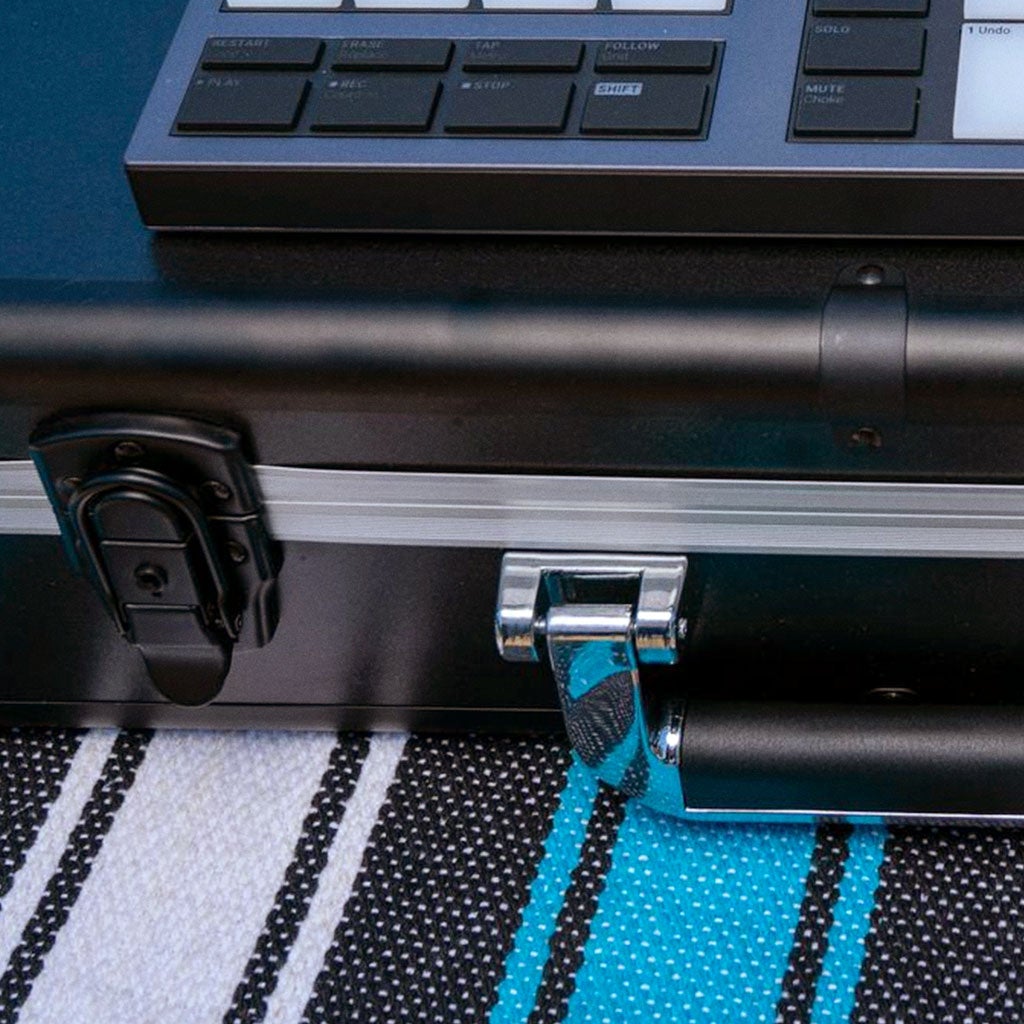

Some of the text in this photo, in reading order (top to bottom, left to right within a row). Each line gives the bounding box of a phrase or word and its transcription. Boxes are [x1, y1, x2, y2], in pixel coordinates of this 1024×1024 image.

[814, 26, 849, 34] SOLO
[968, 26, 1011, 35] 1 Undo
[211, 39, 270, 48] RESTART
[605, 41, 660, 50] FOLLOW
[472, 81, 511, 90] STOP
[598, 83, 640, 94] SHIFT
[805, 84, 845, 93] MUTE
[804, 95, 844, 104] Choke
